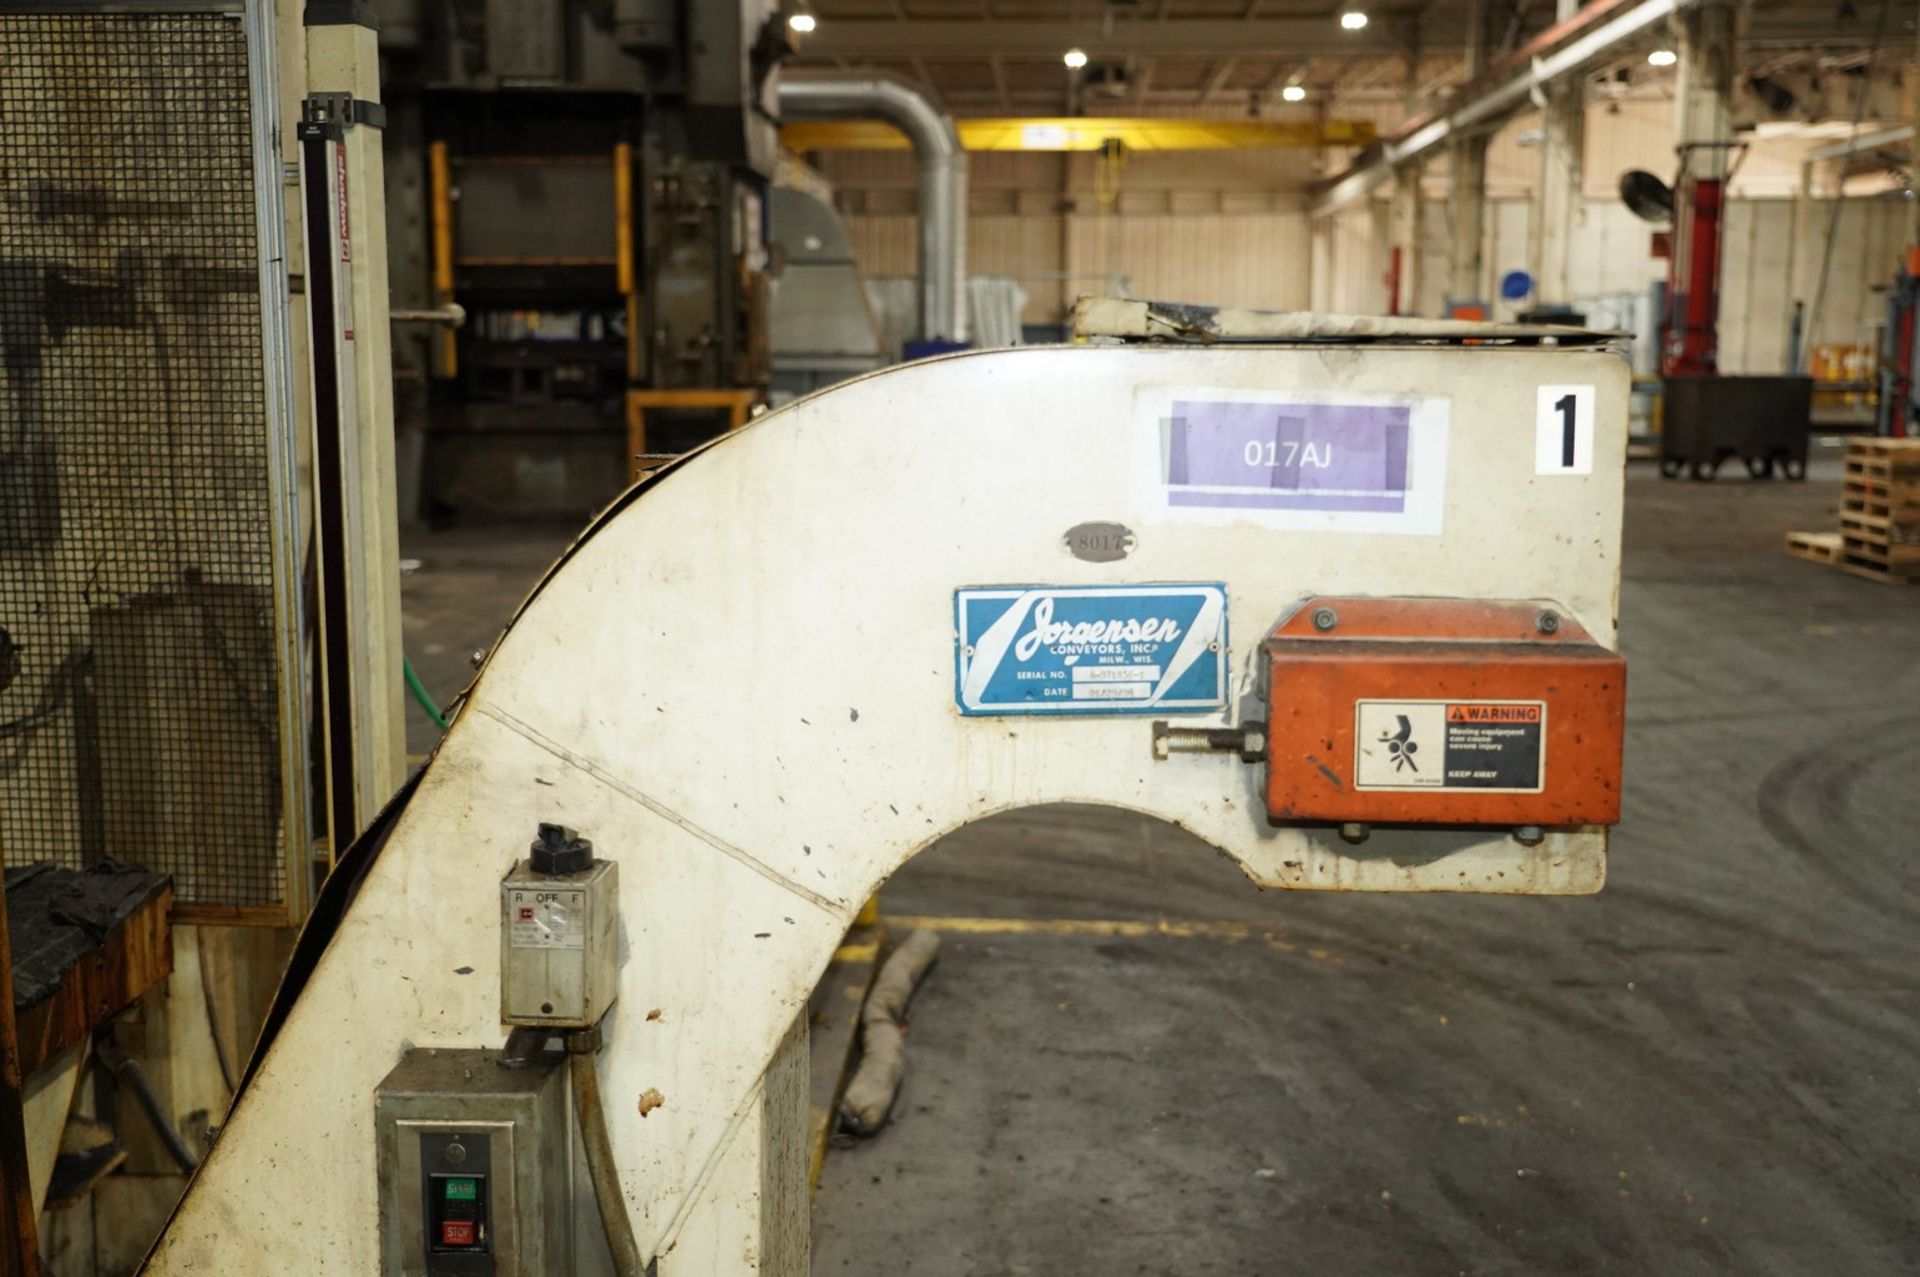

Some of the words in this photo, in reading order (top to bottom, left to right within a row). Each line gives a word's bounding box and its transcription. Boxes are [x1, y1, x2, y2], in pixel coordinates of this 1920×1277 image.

[1554, 394, 1577, 467] 1
[1244, 440, 1332, 468] 017AJ
[1079, 534, 1122, 551] 8017
[1016, 597, 1181, 665] Jorgensen
[1050, 644, 1126, 655] CONVEYORS,
[1133, 655, 1154, 664] WIS.
[1017, 671, 1047, 680] SERIAL
[1050, 670, 1068, 679] NO.
[1044, 687, 1068, 697] DATE
[1467, 708, 1537, 720] WARNING
[1449, 728, 1480, 736] Moving
[1481, 728, 1525, 737] equipment
[1448, 770, 1472, 778] KEEP
[1472, 770, 1498, 778] AWAY
[515, 893, 524, 902] R
[536, 893, 559, 903] OFF
[572, 893, 580, 903] F
[447, 1226, 470, 1237] STOP
